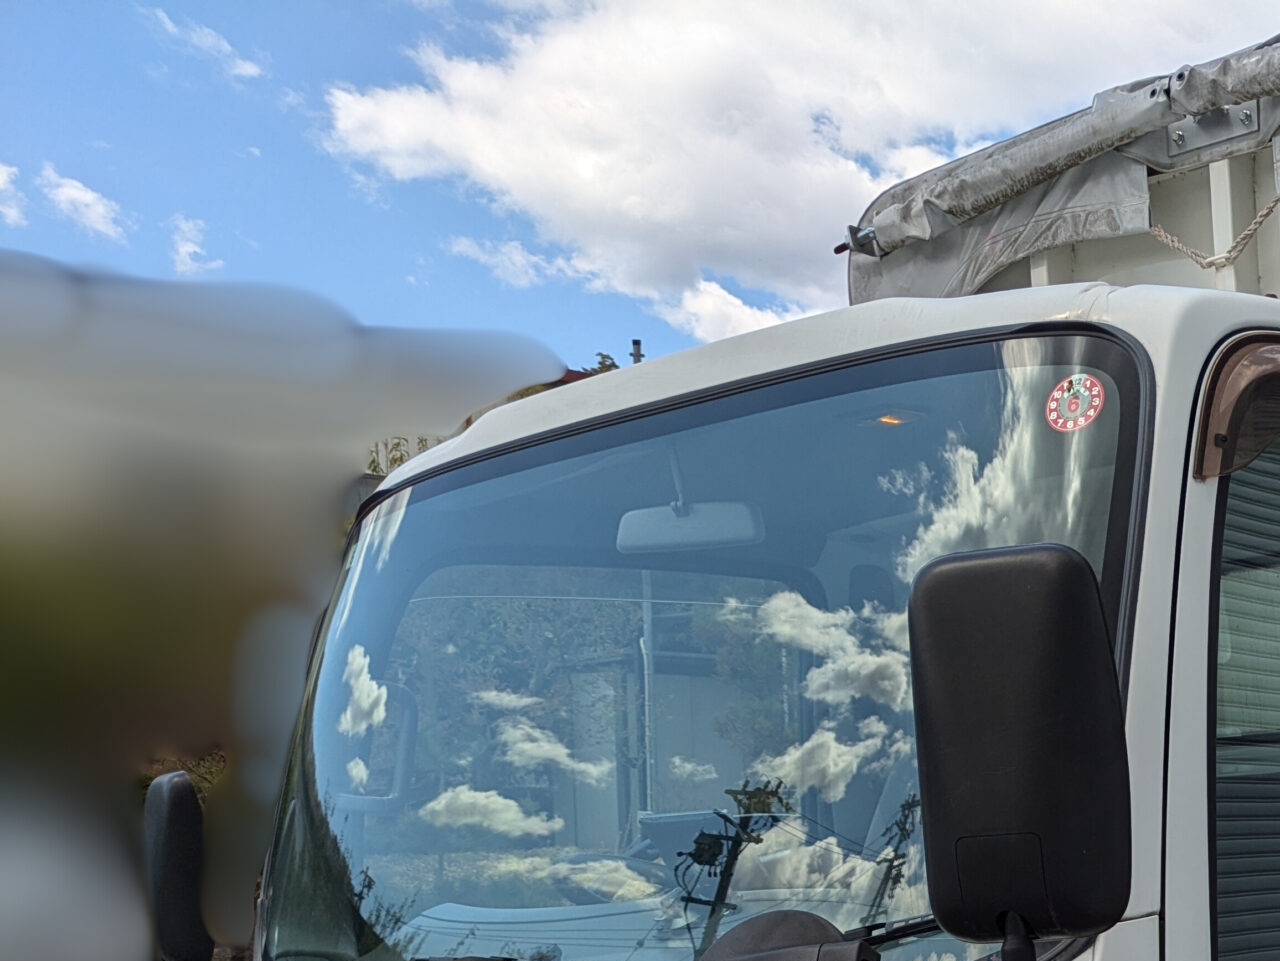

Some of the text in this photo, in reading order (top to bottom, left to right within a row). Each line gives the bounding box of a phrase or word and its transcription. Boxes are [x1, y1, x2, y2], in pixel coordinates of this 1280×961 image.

[1074, 378, 1082, 386] 12
[1086, 380, 1091, 388] 1
[1054, 391, 1062, 399] 10
[1092, 387, 1099, 395] 2
[1050, 401, 1057, 409] 9
[1092, 398, 1100, 406] 3
[1050, 412, 1057, 420] 8
[1057, 419, 1064, 427] 7
[1078, 417, 1085, 425] 5
